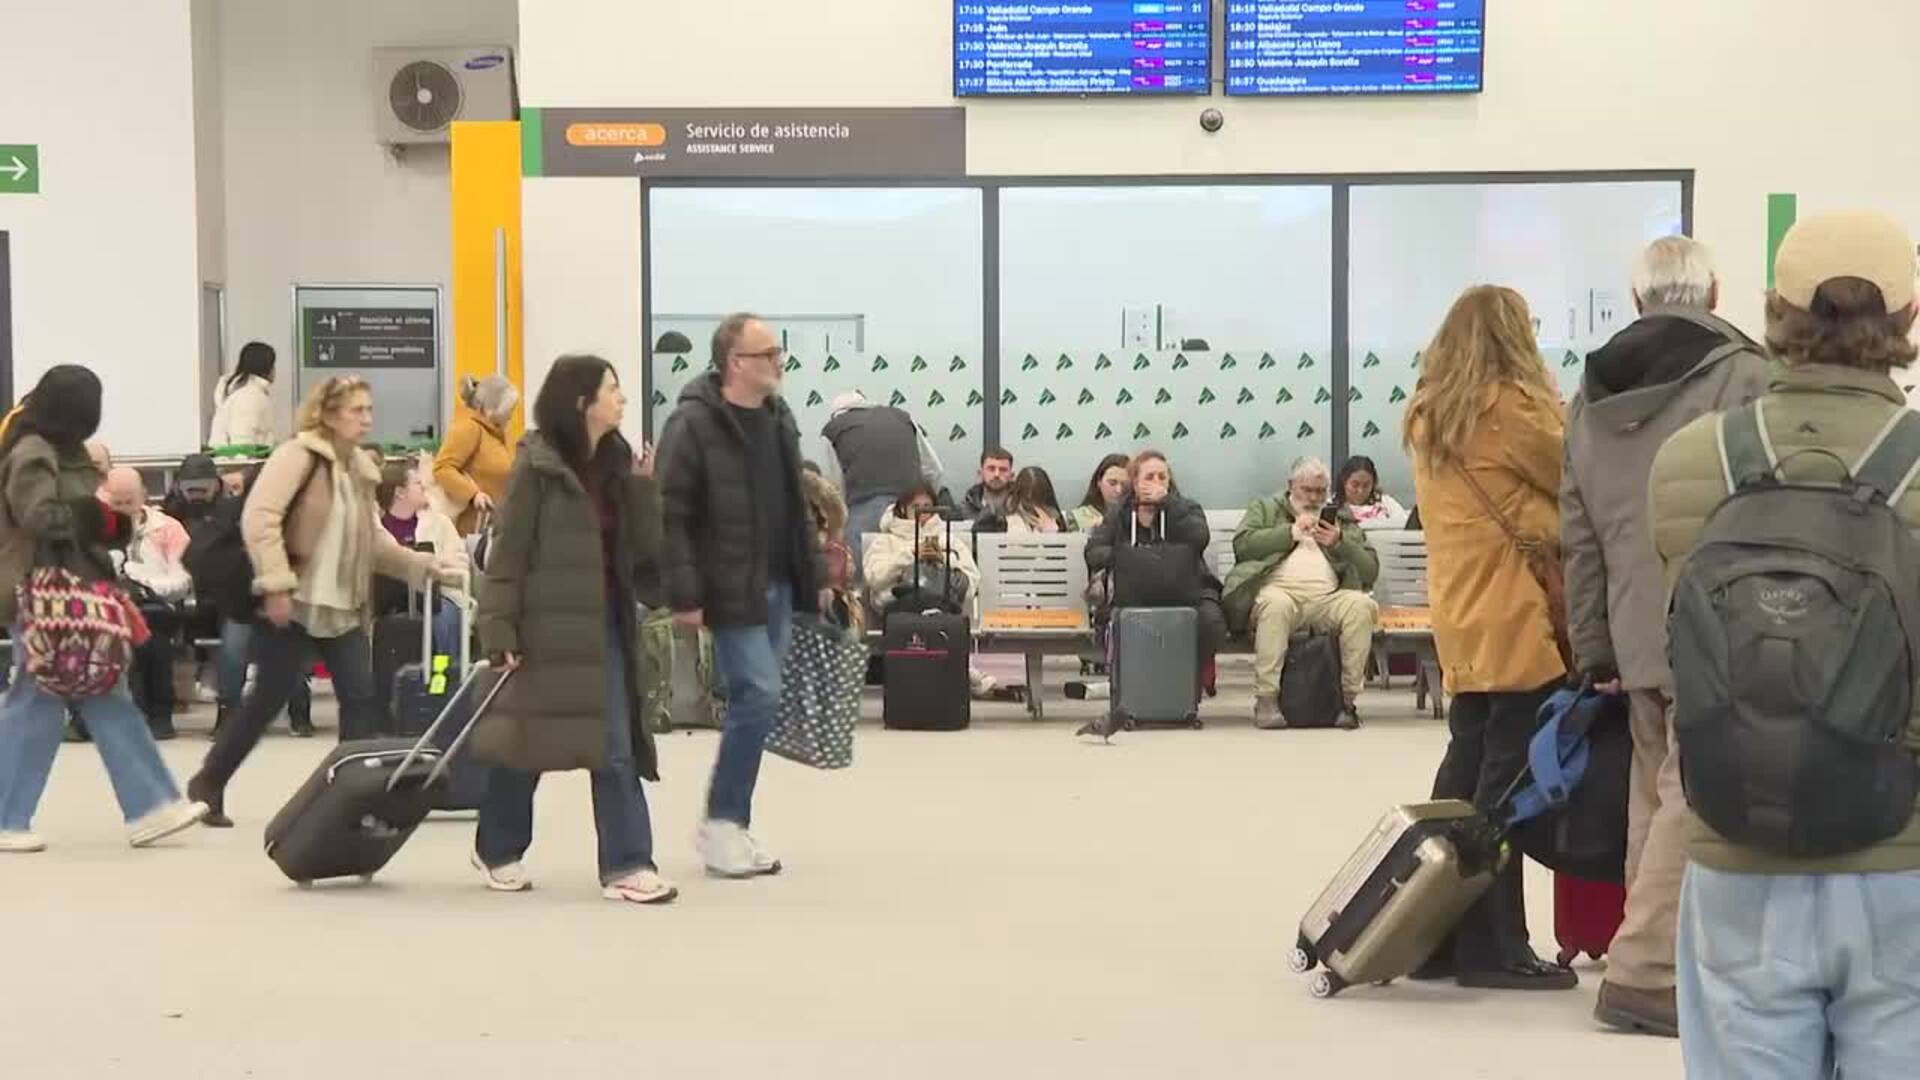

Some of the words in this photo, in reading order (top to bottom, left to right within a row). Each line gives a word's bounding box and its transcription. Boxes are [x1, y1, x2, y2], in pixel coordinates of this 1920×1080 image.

[1030, 5, 1060, 16] Campo
[1062, 5, 1092, 14] Grande
[1301, 3, 1332, 15] Campo
[1333, 3, 1364, 12] Grande
[584, 128, 648, 141] acerca
[686, 122, 745, 139] Servicio
[750, 122, 769, 138] de
[774, 122, 850, 139] asistencia
[686, 143, 738, 154] ASSISTANCE
[739, 143, 775, 154] SERVICE
